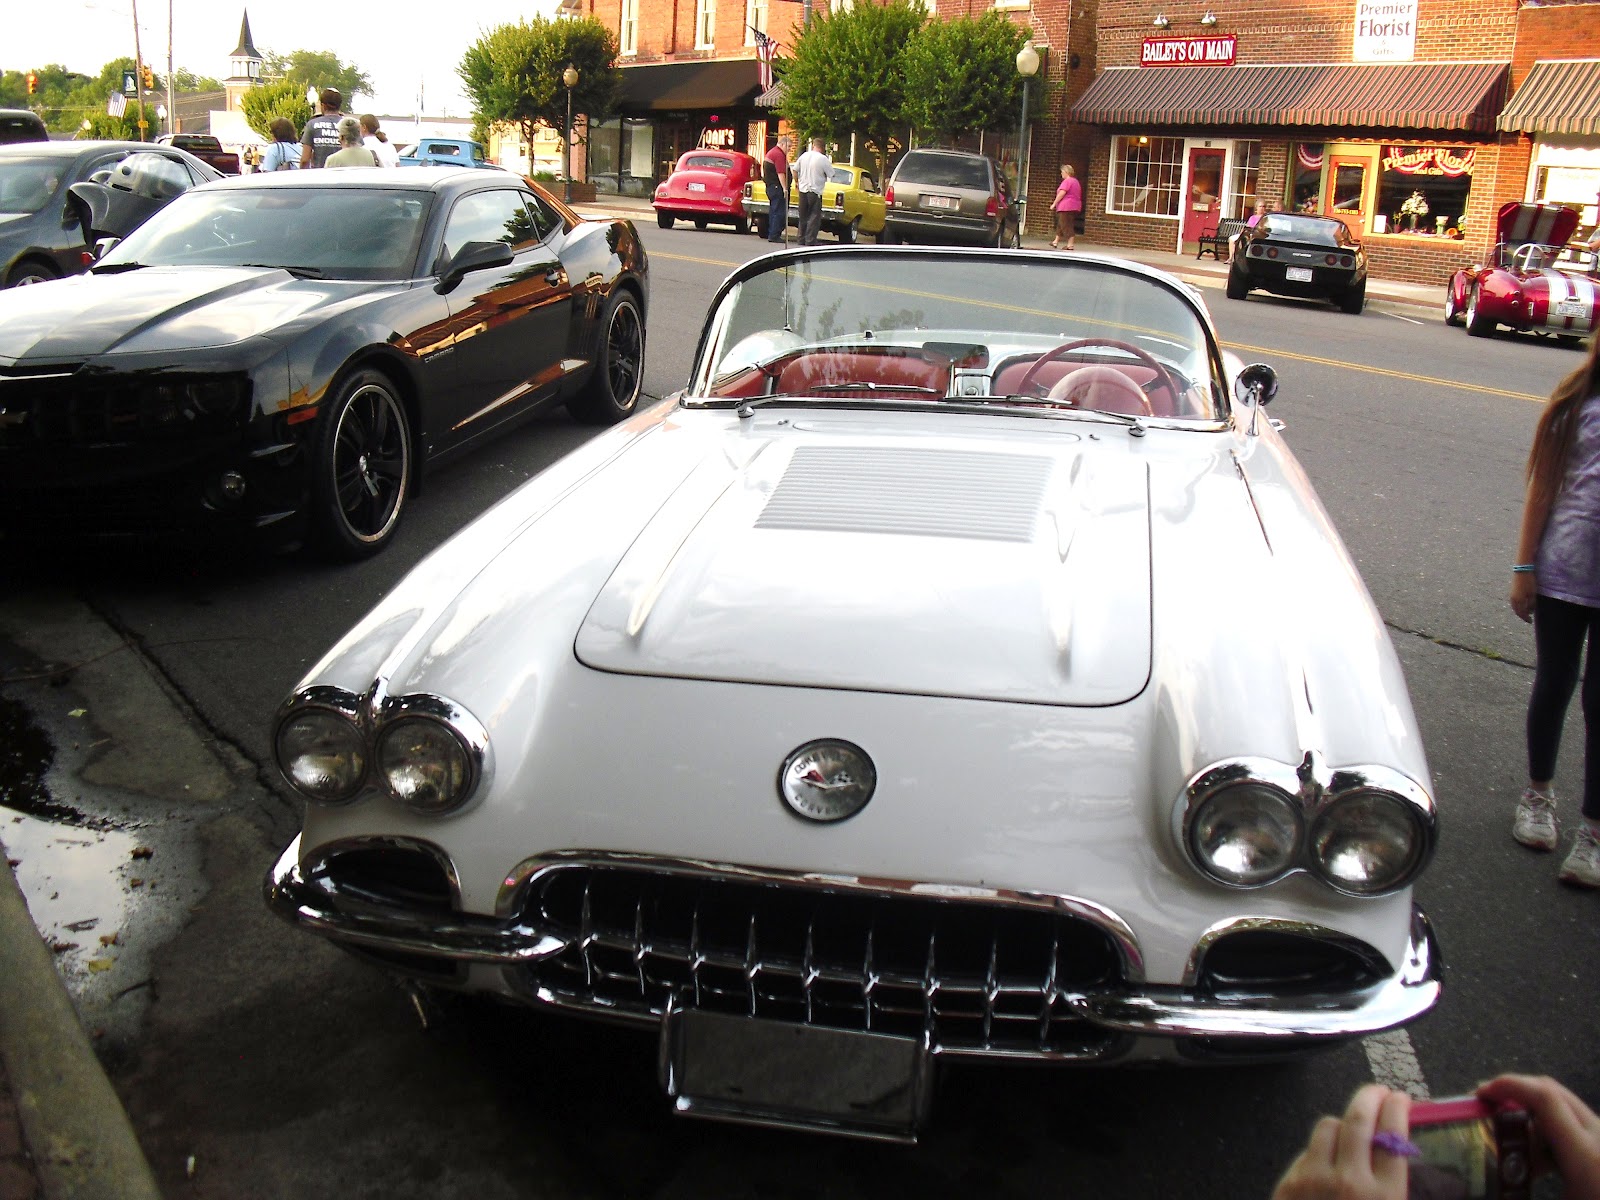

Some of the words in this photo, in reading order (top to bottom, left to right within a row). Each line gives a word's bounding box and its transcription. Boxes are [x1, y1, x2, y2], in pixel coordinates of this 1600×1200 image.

[1360, 2, 1413, 15] Premier
[1359, 19, 1410, 37] Florist
[1142, 42, 1187, 62] BAILEY'S
[1188, 41, 1204, 61] ON
[1205, 40, 1234, 60] MAIN
[313, 121, 332, 129] ARE
[1382, 149, 1435, 171] Premier
